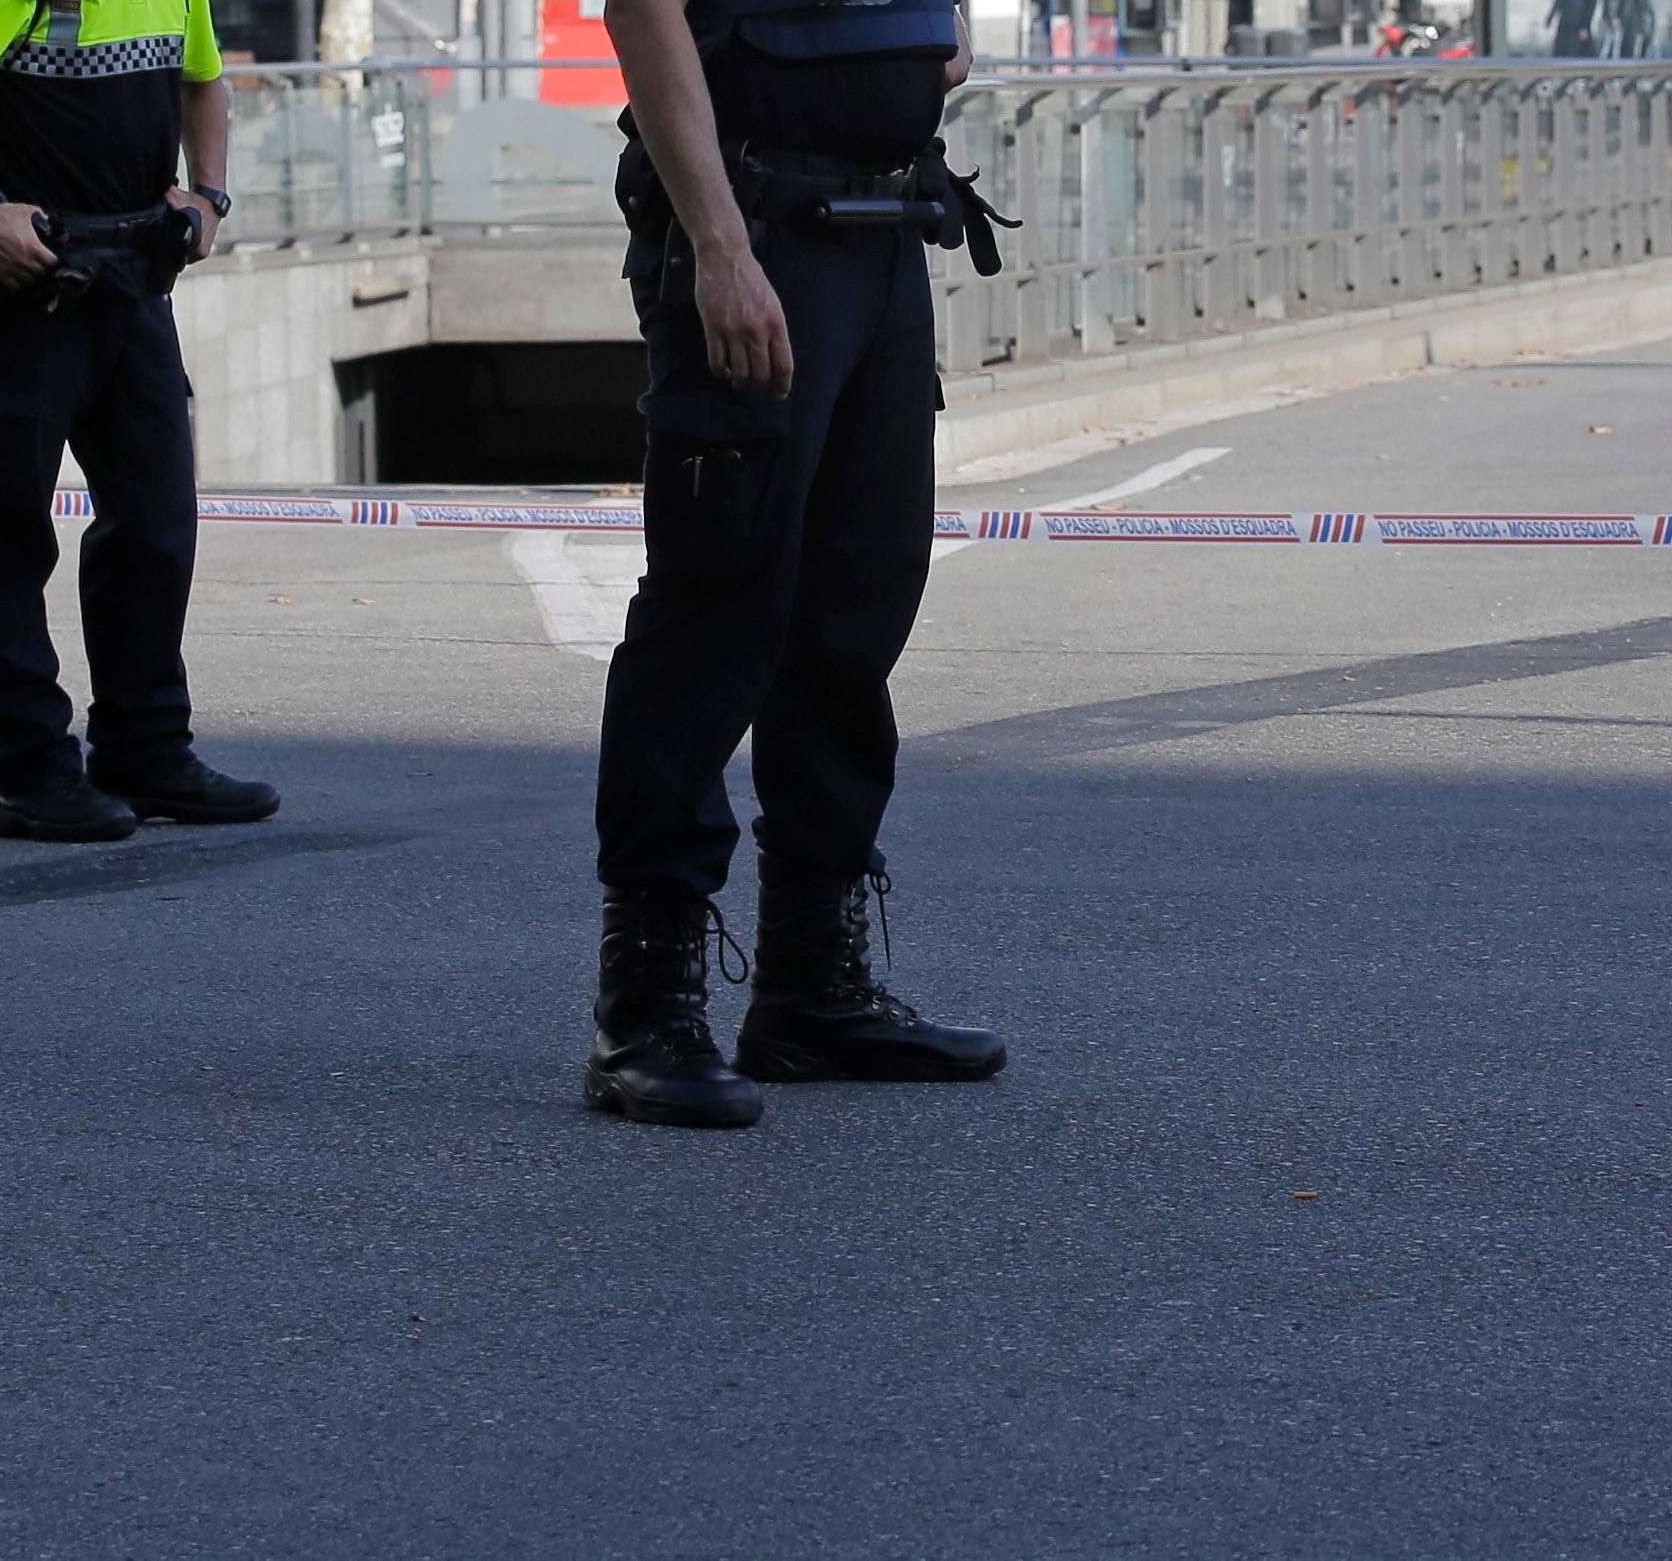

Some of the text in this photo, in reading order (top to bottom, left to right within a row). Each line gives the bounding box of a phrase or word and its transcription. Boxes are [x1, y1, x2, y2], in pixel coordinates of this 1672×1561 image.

[936, 516, 966, 530] ADRA
[1046, 518, 1063, 533] NO
[1066, 519, 1110, 534] PASSEU
[1118, 519, 1164, 534] POLICIA
[1170, 520, 1219, 535] MOSSOS
[1221, 520, 1297, 536] D'ESQUADRA
[1379, 521, 1398, 536] NO
[1401, 521, 1446, 536] PASSEU
[1453, 521, 1501, 537] POLICIA
[1508, 521, 1561, 537] MOSSOS
[1563, 522, 1639, 538] D'ESQUADRA
